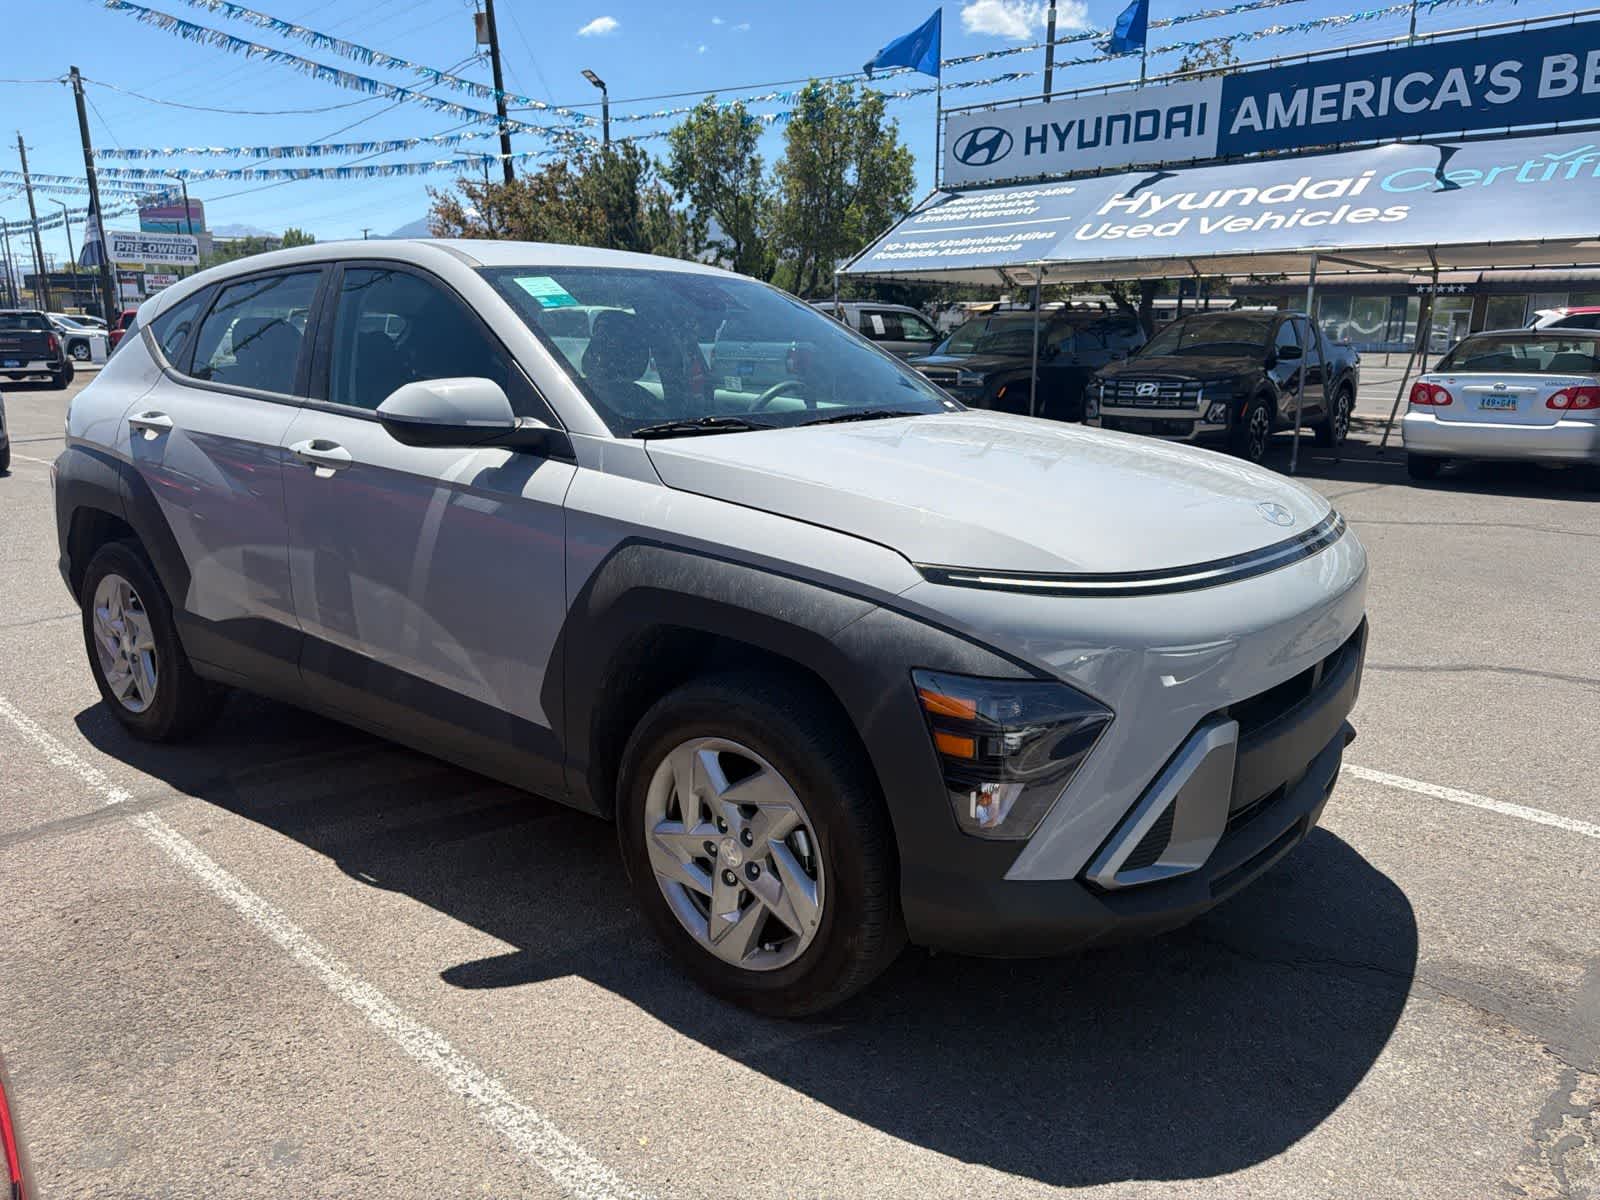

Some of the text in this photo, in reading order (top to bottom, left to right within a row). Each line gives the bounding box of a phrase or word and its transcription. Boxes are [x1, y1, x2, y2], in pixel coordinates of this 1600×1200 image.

[1229, 61, 1523, 135] AMERICA’S
[1024, 102, 1208, 156] HYUNDAI
[1098, 170, 1377, 218] Hyundai
[1074, 204, 1412, 241] Used Vehicles
[116, 242, 195, 254] PRE-OWNED
[938, 243, 1023, 257] Assistance
